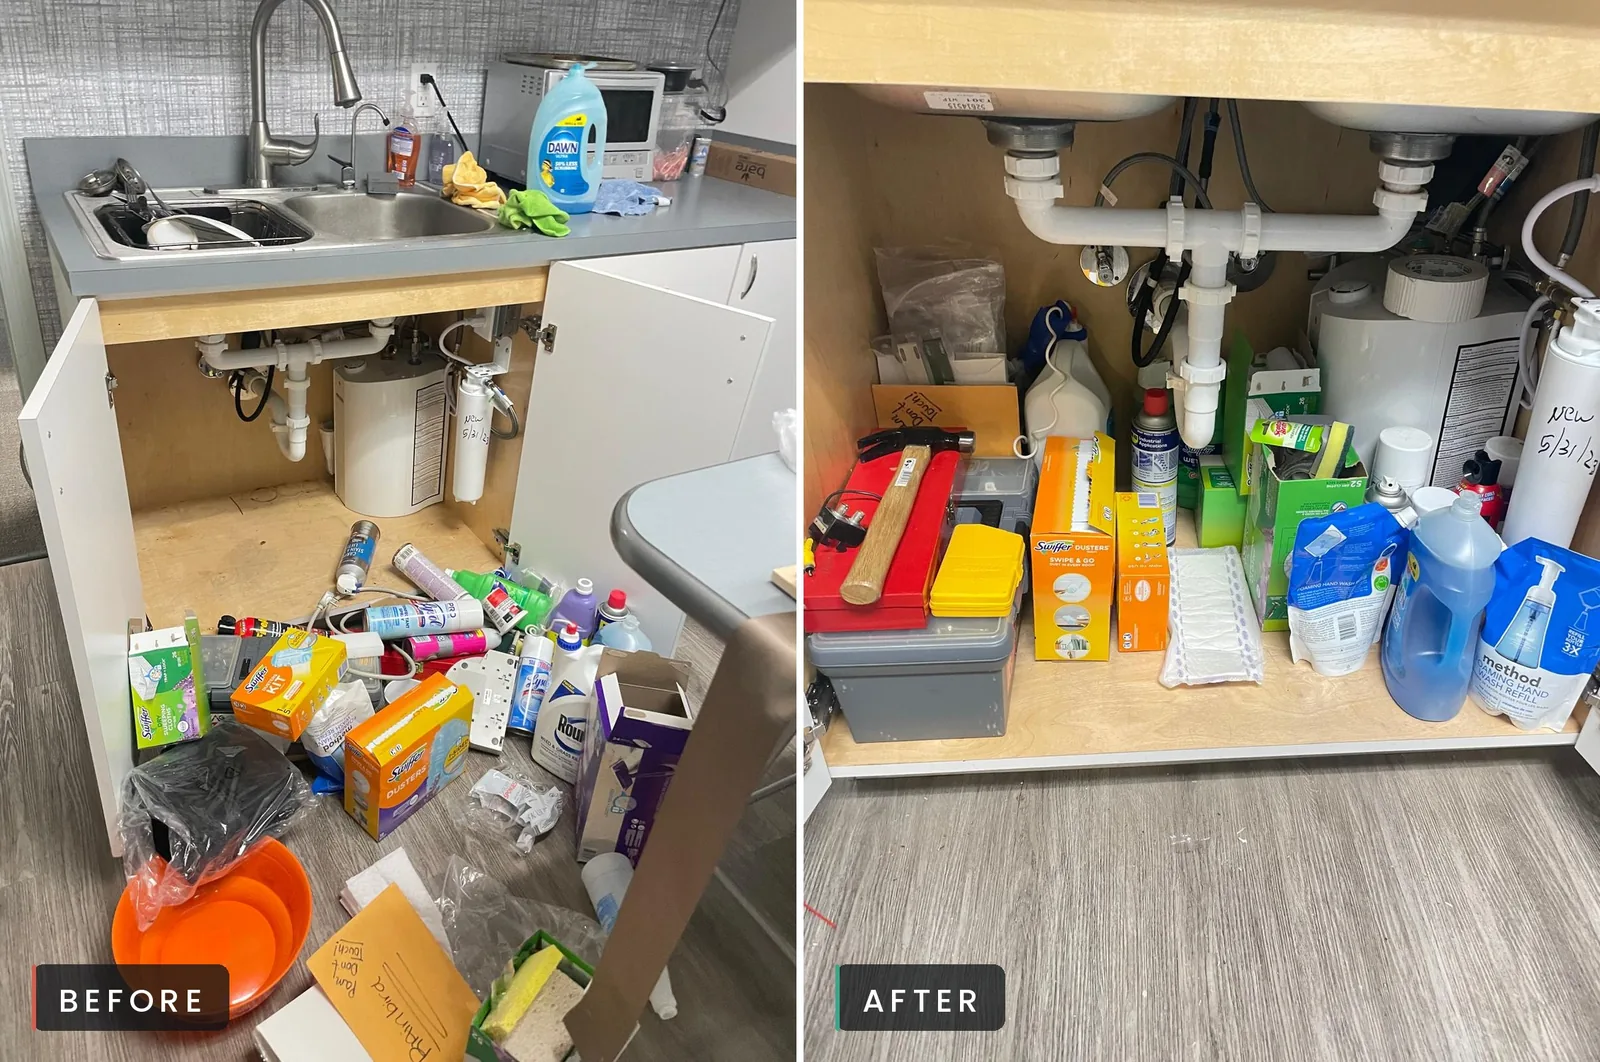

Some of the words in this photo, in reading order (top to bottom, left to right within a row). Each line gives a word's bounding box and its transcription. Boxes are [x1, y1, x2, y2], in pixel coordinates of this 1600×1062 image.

[548, 142, 578, 153] DAWN
[1034, 541, 1073, 553] Swiffer
[1568, 630, 1585, 640] REFILL
[1568, 634, 1584, 643] YOUR
[1562, 642, 1582, 656] 3X
[245, 666, 268, 694] Swiffer
[1478, 659, 1514, 686] OAMING
[1516, 683, 1548, 699] HAND
[1482, 654, 1541, 688] method
[267, 675, 286, 695] KIT
[1479, 670, 1504, 692] WASH
[1505, 687, 1536, 704] REFILL
[141, 706, 152, 740] Swiffer
[323, 725, 353, 752] method
[388, 748, 425, 784] Swiffer
[386, 766, 426, 799] DUSTERS
